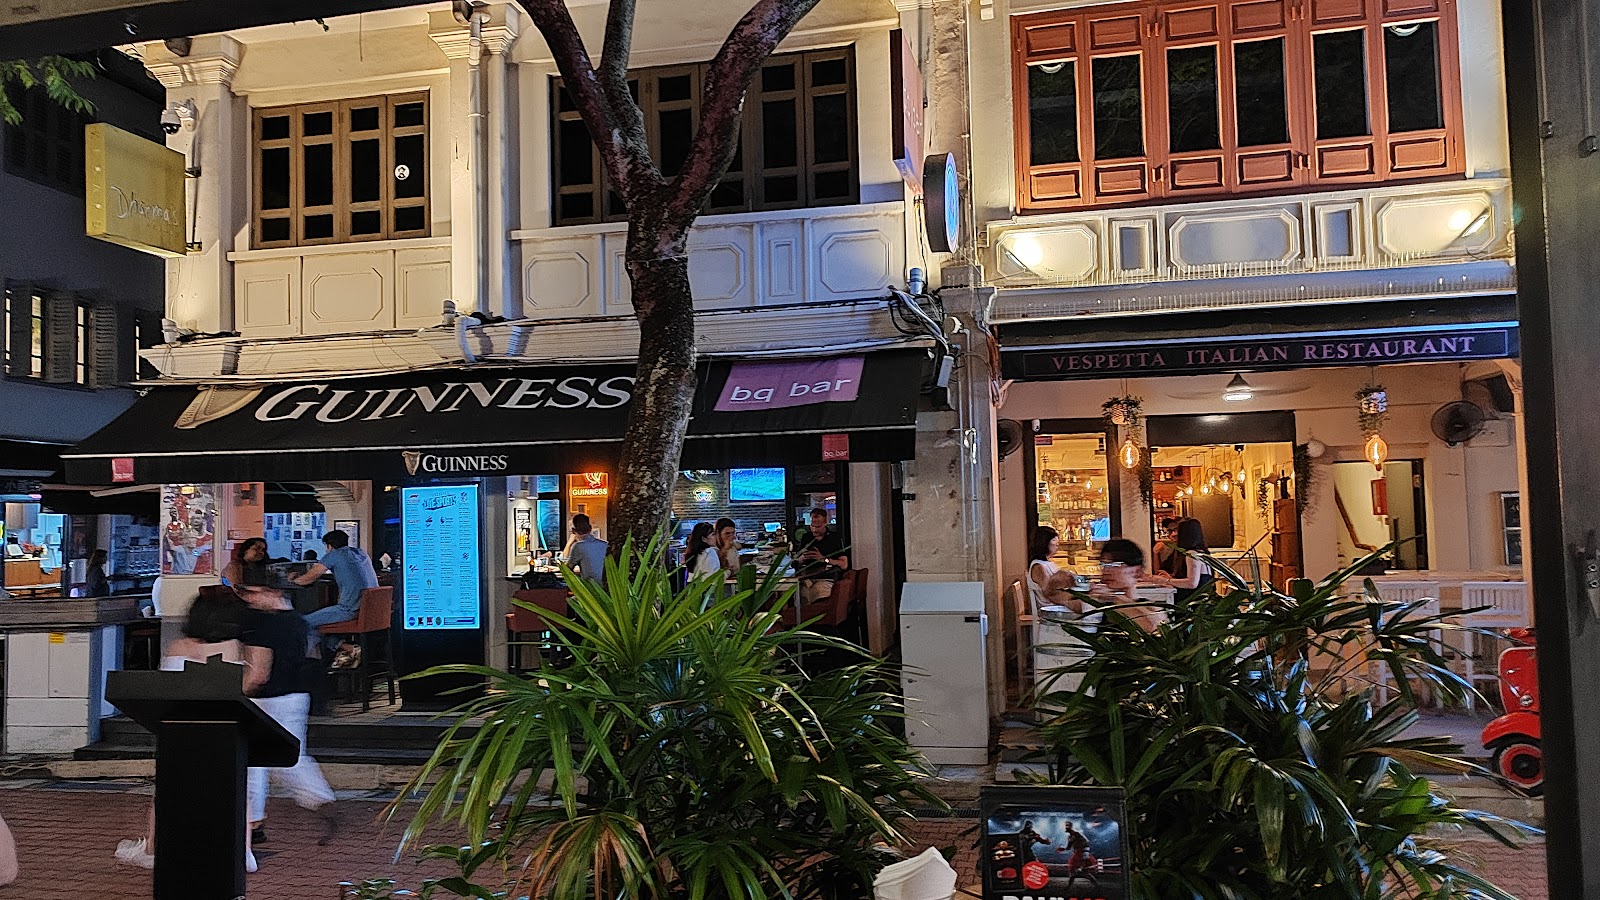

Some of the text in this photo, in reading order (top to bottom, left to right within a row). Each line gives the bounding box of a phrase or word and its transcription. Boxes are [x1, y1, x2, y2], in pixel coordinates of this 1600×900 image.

[1052, 337, 1476, 371] VESPETTA ITALIAN RESTAURANT
[254, 376, 637, 423] GUINNESS
[730, 378, 852, 402] bq bar
[422, 454, 509, 472] GUINNESS
[572, 488, 608, 496] GUINNESS
